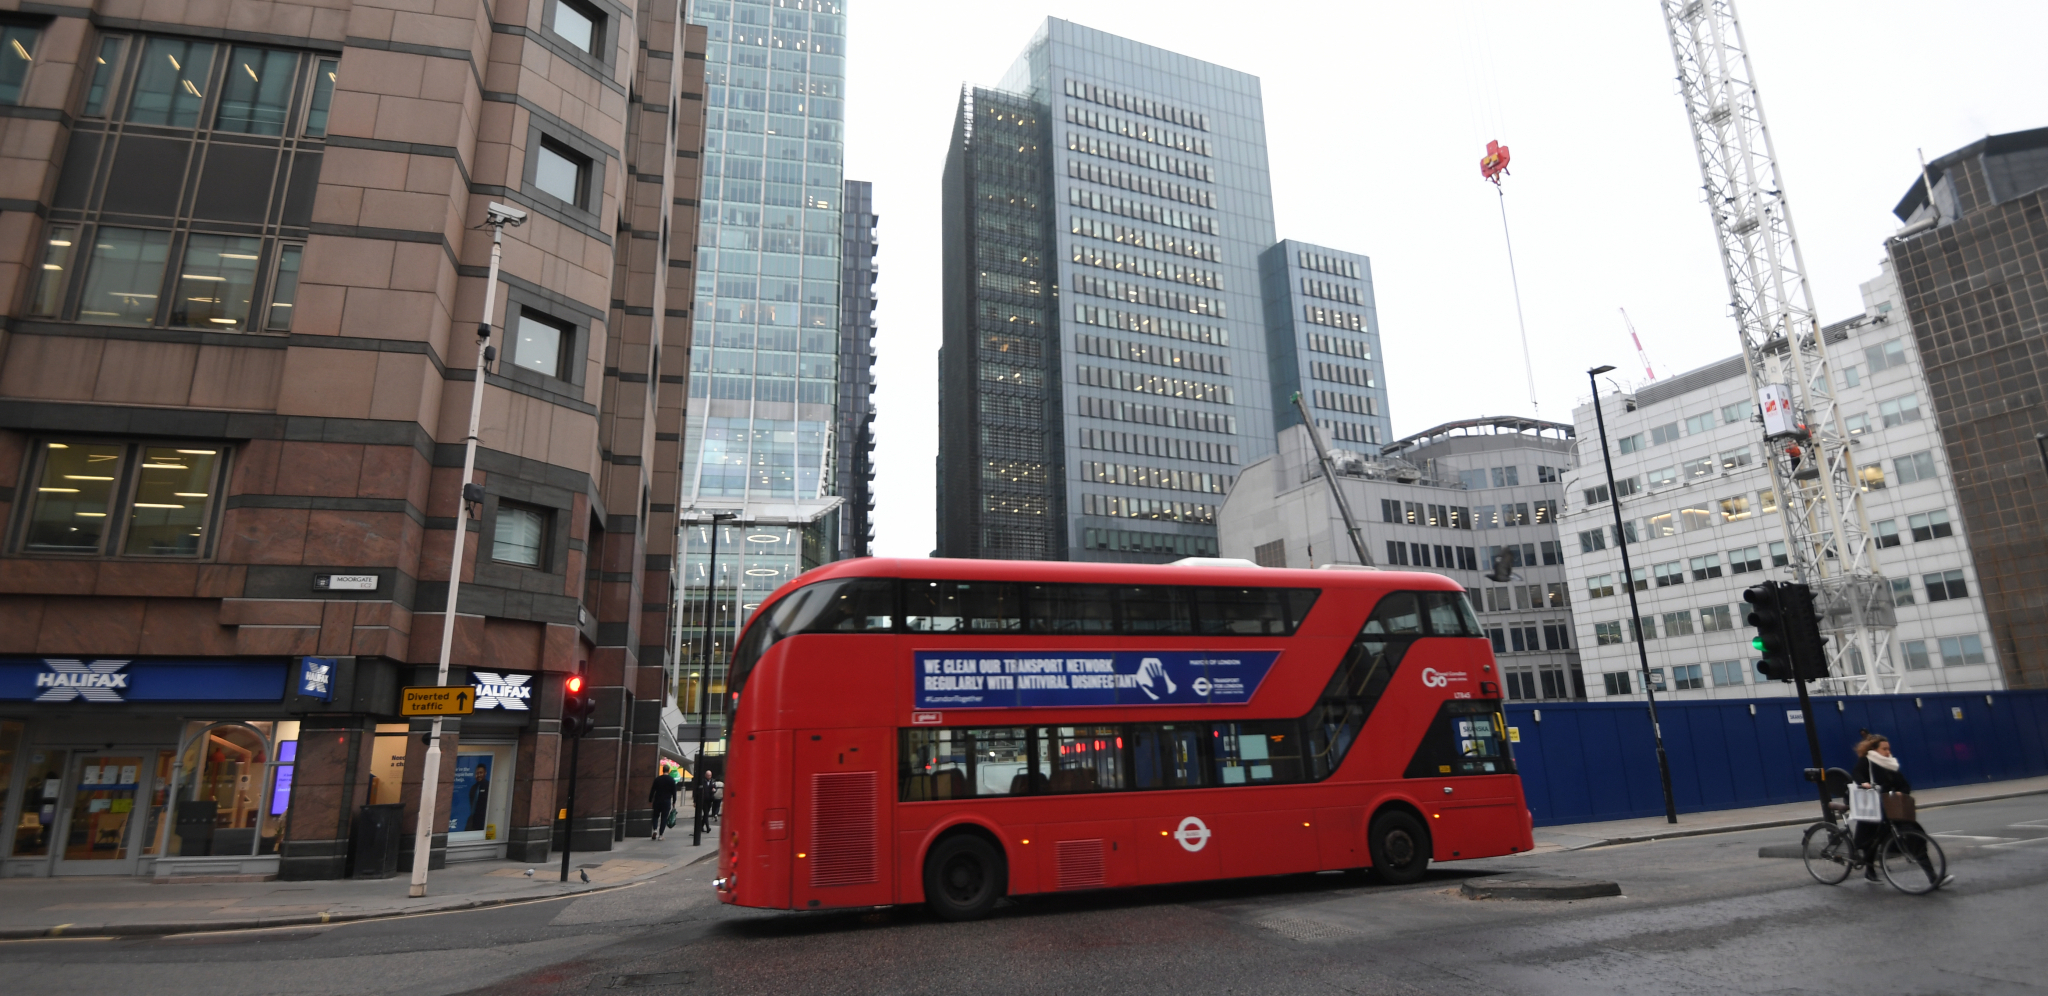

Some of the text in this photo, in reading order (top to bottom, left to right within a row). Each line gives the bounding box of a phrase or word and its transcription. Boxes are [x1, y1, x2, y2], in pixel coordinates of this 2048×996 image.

[924, 659, 1114, 674] WE CLEAN OUR TRANSPORT NETWORK
[37, 672, 128, 687] HALIFAX
[305, 671, 329, 684] HALIFAX
[924, 674, 1137, 690] REGULARLY WITH ANTIVIRAL DISINFECTANT
[1421, 667, 1447, 687] Go
[408, 692, 449, 701] Diverted
[412, 702, 443, 711] traffic
